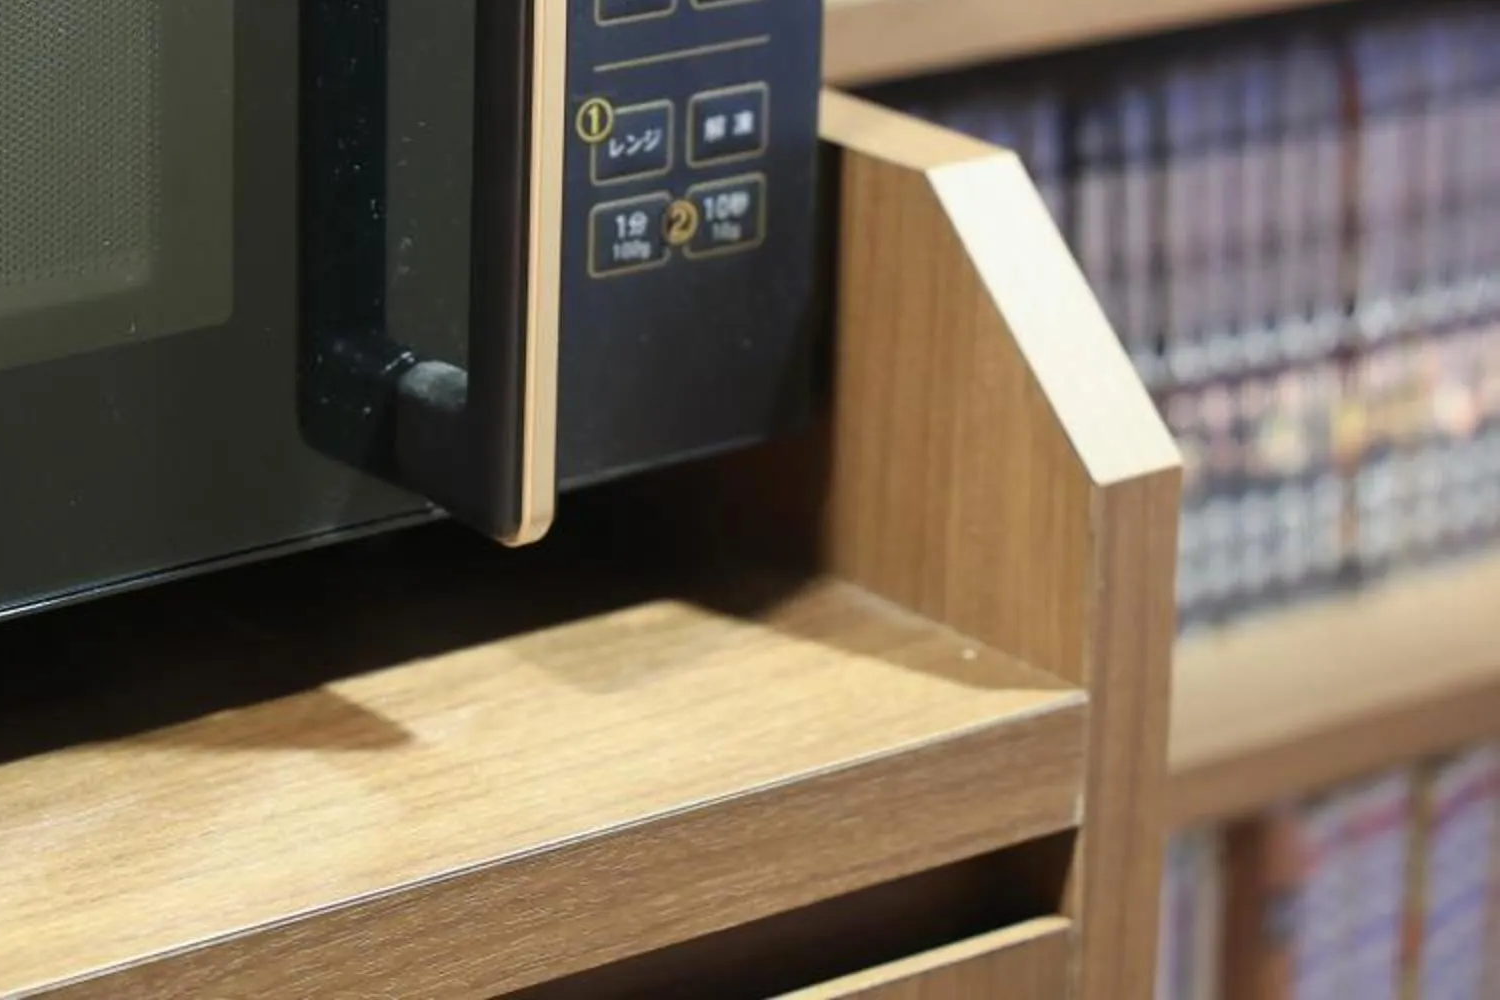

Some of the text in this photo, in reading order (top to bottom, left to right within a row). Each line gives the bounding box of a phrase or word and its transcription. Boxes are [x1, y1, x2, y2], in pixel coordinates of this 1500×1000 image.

[608, 128, 663, 158] レンジ
[615, 210, 649, 240] 1分
